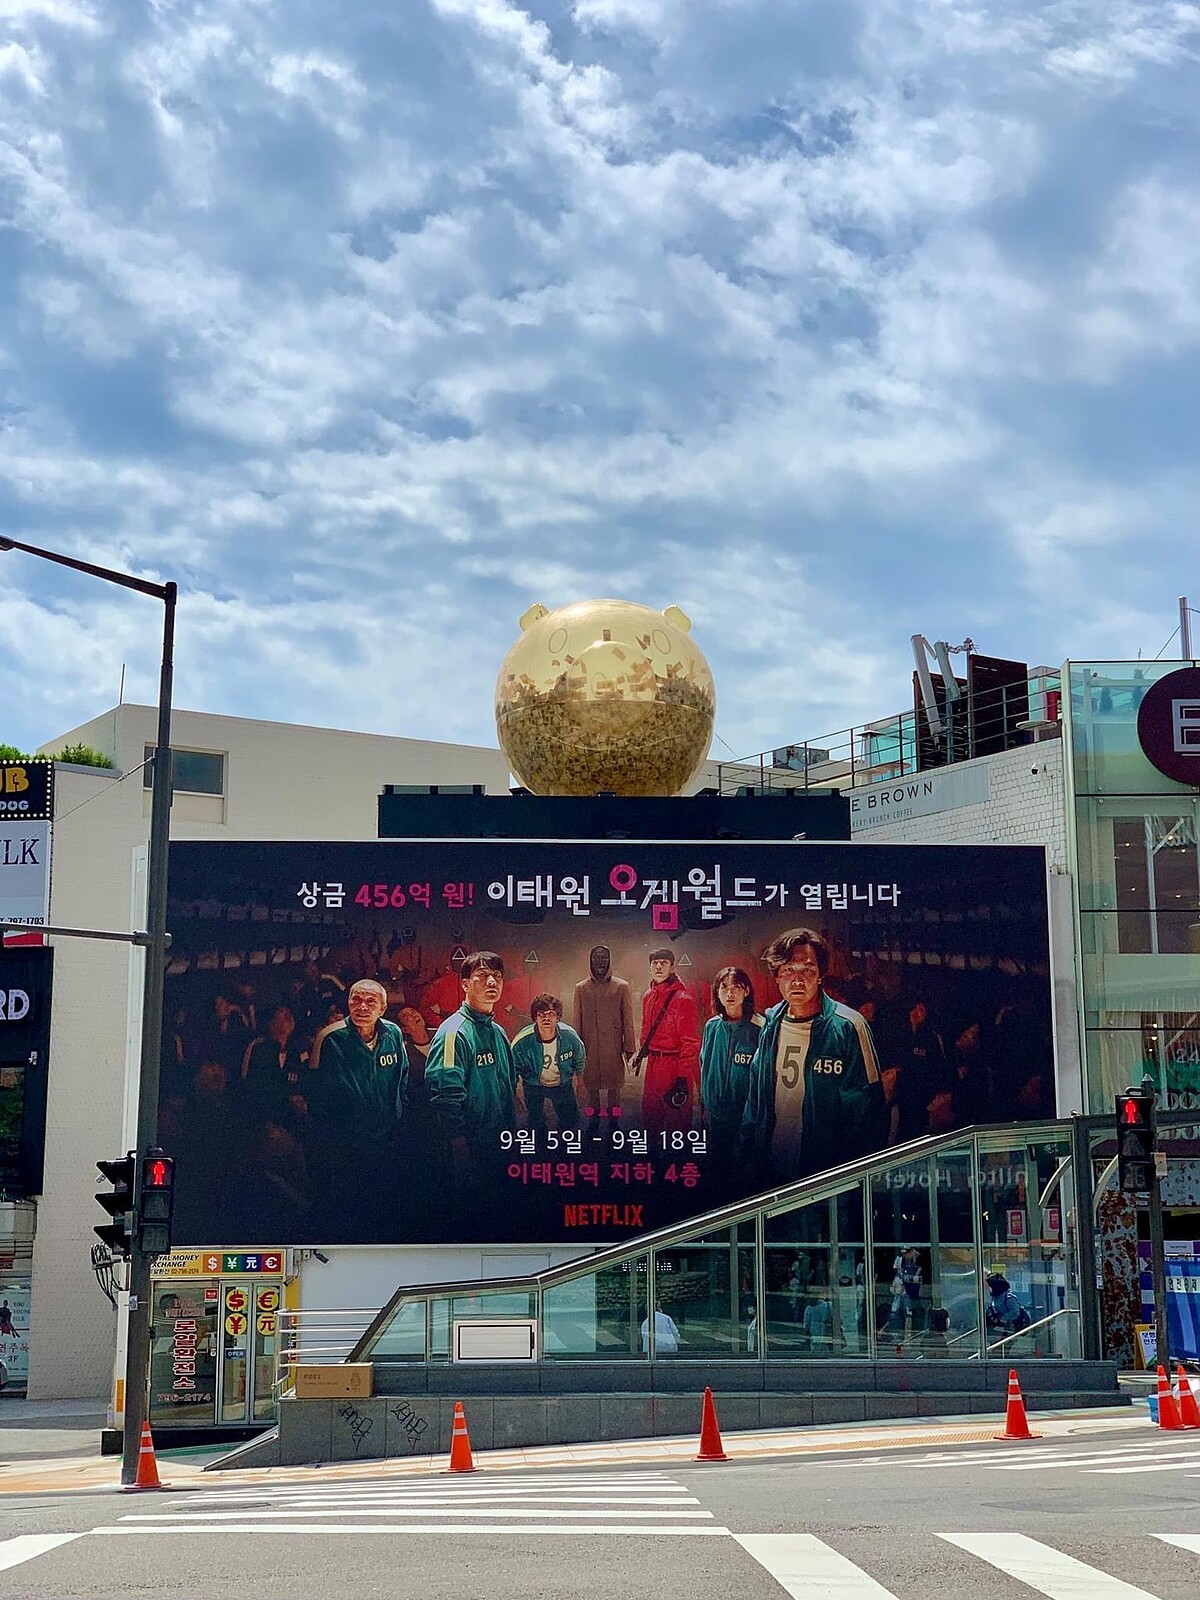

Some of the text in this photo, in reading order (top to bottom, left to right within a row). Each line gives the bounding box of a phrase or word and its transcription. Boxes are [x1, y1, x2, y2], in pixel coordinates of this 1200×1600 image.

[0, 767, 29, 793] B
[867, 781, 933, 809] BROWN
[869, 813, 890, 825] BRUNCH
[893, 807, 913, 820] COFFEE
[0, 838, 40, 866] LK
[296, 881, 346, 909] 상금
[354, 882, 431, 909] 456억
[442, 882, 474, 909] 원!
[487, 874, 590, 916] 이태원
[799, 882, 902, 910] 열립니다
[379, 1053, 398, 1067] 001
[476, 1053, 494, 1067] 218
[560, 1051, 573, 1062] 199
[734, 1053, 752, 1064] 067
[813, 1059, 843, 1075] 456
[500, 1129, 536, 1154] 9월
[546, 1129, 582, 1154] 5일
[612, 1129, 648, 1154] 9월
[659, 1129, 707, 1154] 18일
[507, 1162, 701, 1188] 이태원역 지하 4층
[564, 1204, 644, 1227] NETFLIX
